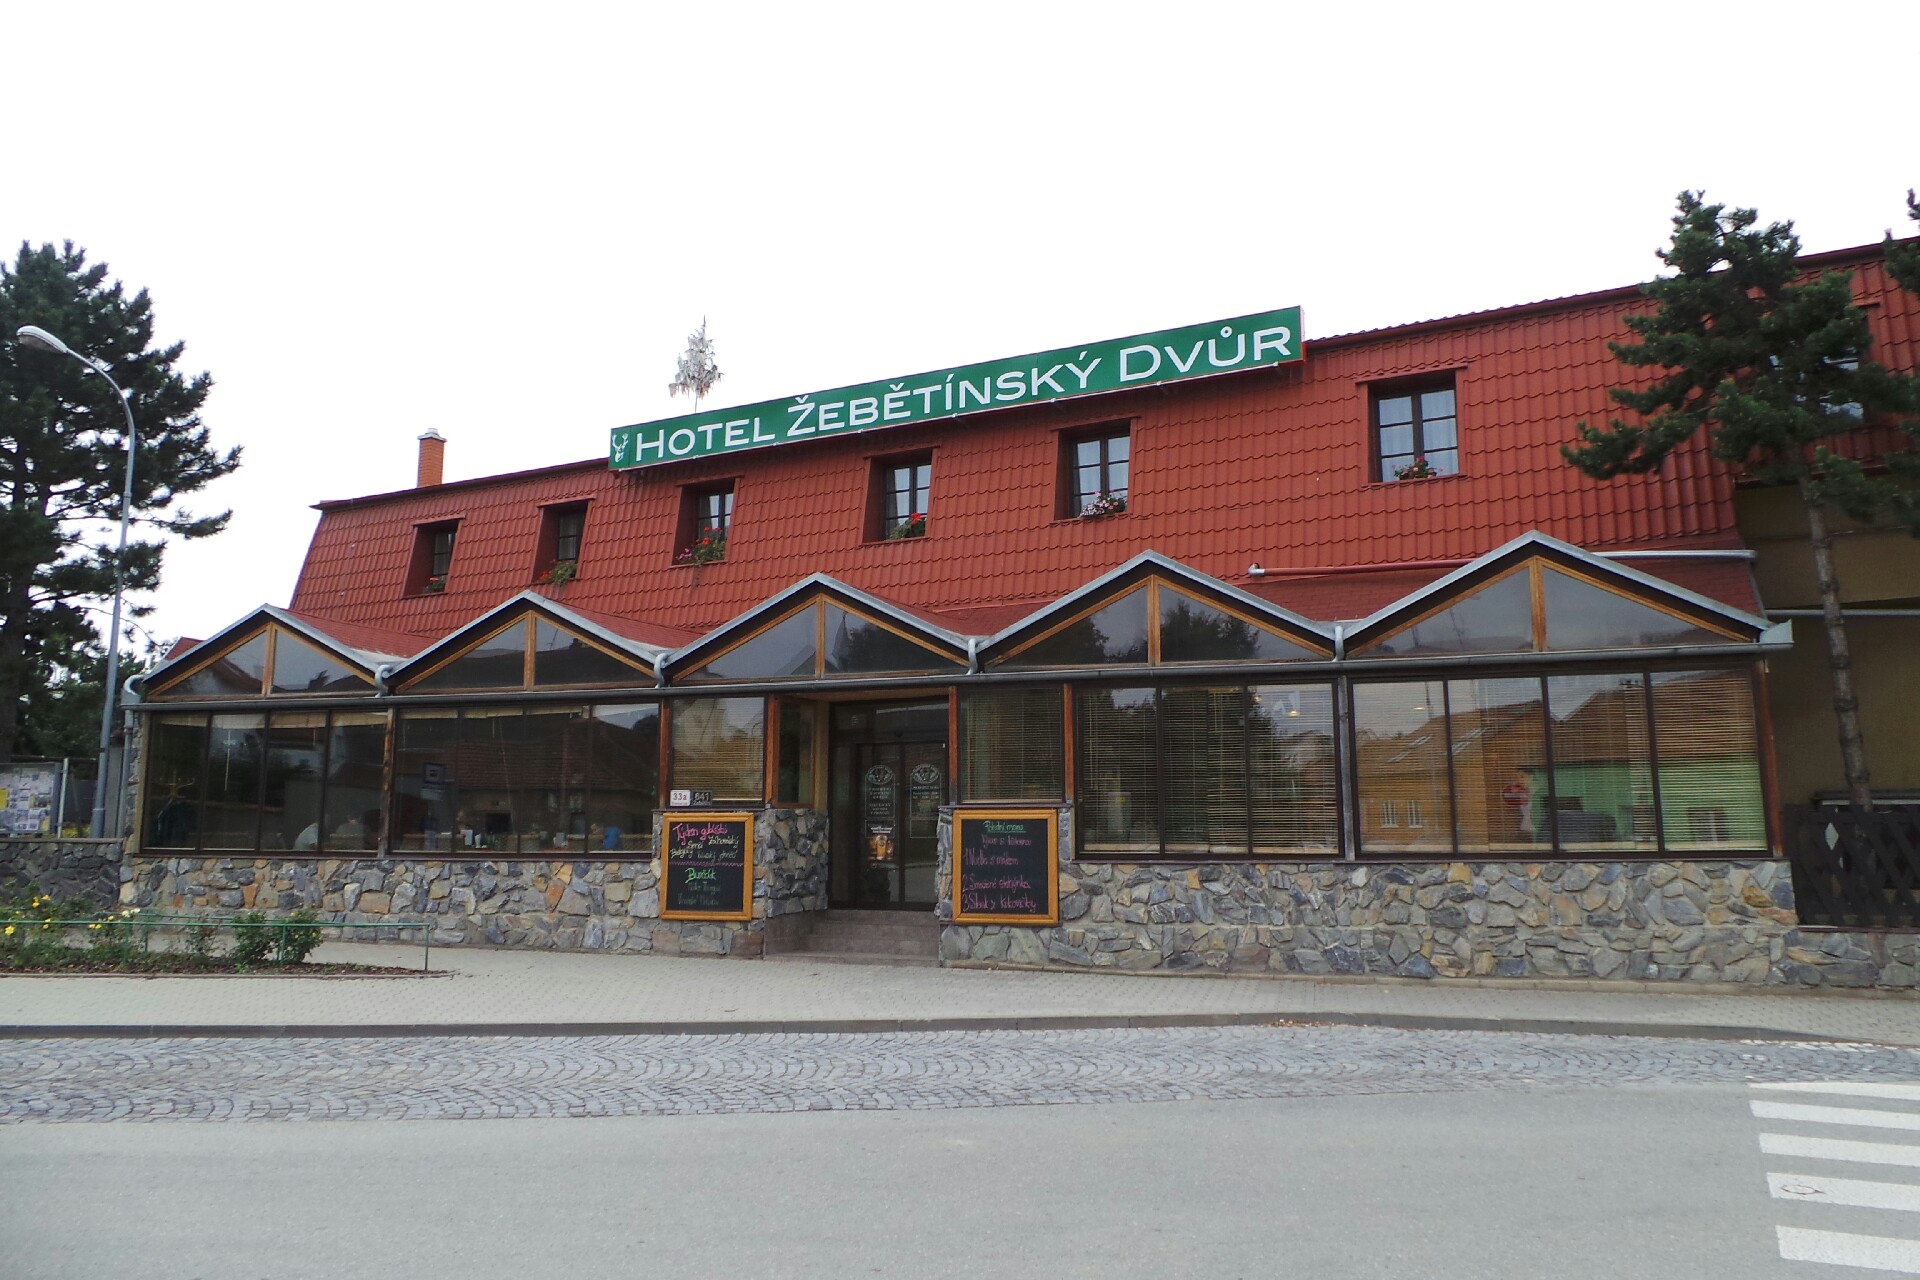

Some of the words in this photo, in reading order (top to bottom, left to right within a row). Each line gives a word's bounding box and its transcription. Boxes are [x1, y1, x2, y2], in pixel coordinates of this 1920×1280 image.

[635, 417, 776, 462] HOTEL
[786, 351, 1102, 437] ŽEBĚTÍNSKÝ
[1120, 326, 1292, 382] DVŮR
[672, 792, 687, 801] 33a
